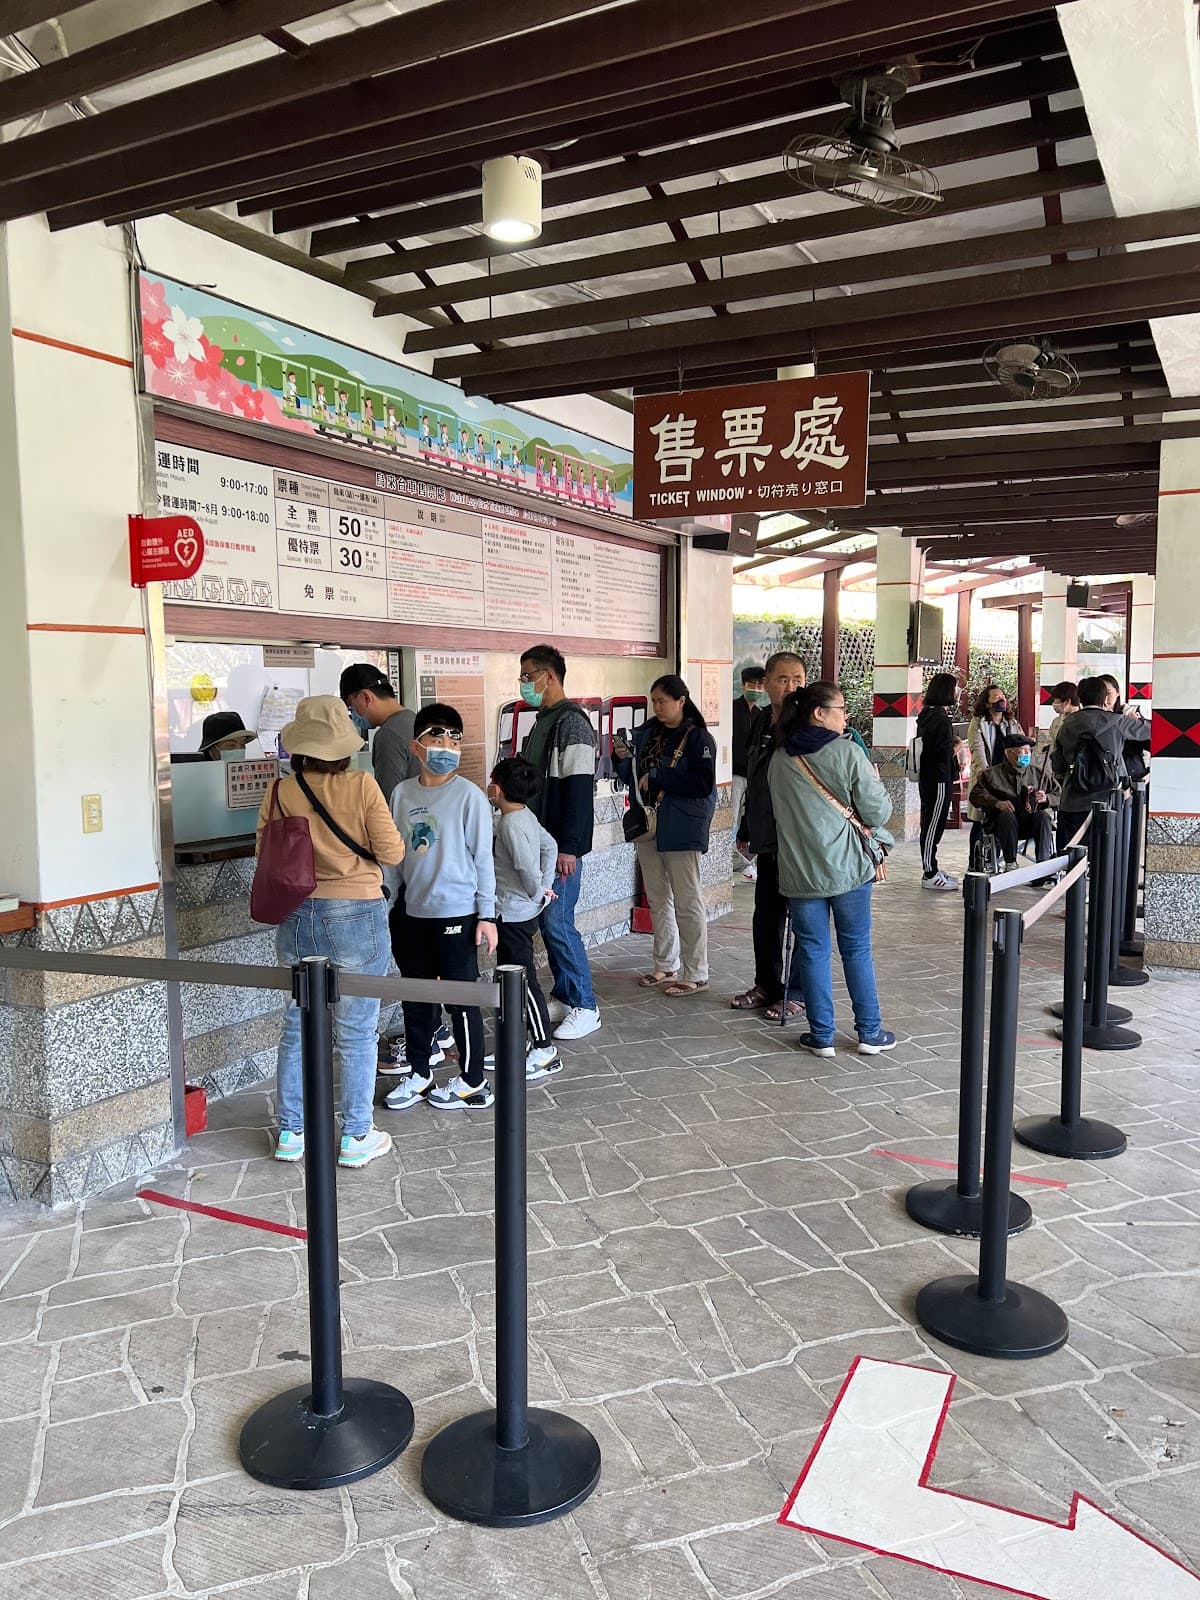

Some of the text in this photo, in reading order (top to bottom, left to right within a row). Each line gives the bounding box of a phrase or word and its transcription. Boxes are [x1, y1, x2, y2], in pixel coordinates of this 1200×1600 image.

[650, 396, 850, 484] 售票處
[220, 477, 268, 496] 9:00-17:00
[278, 477, 299, 496] 票種
[757, 480, 843, 499] 切符売り窓口
[650, 486, 745, 507] TICKET WINDOW
[221, 505, 269, 523] 9:00-18:00
[177, 528, 194, 538] AED
[339, 516, 361, 538] 50
[288, 537, 320, 555] 優待票
[340, 547, 362, 568] 30
[304, 584, 334, 600] 免票
